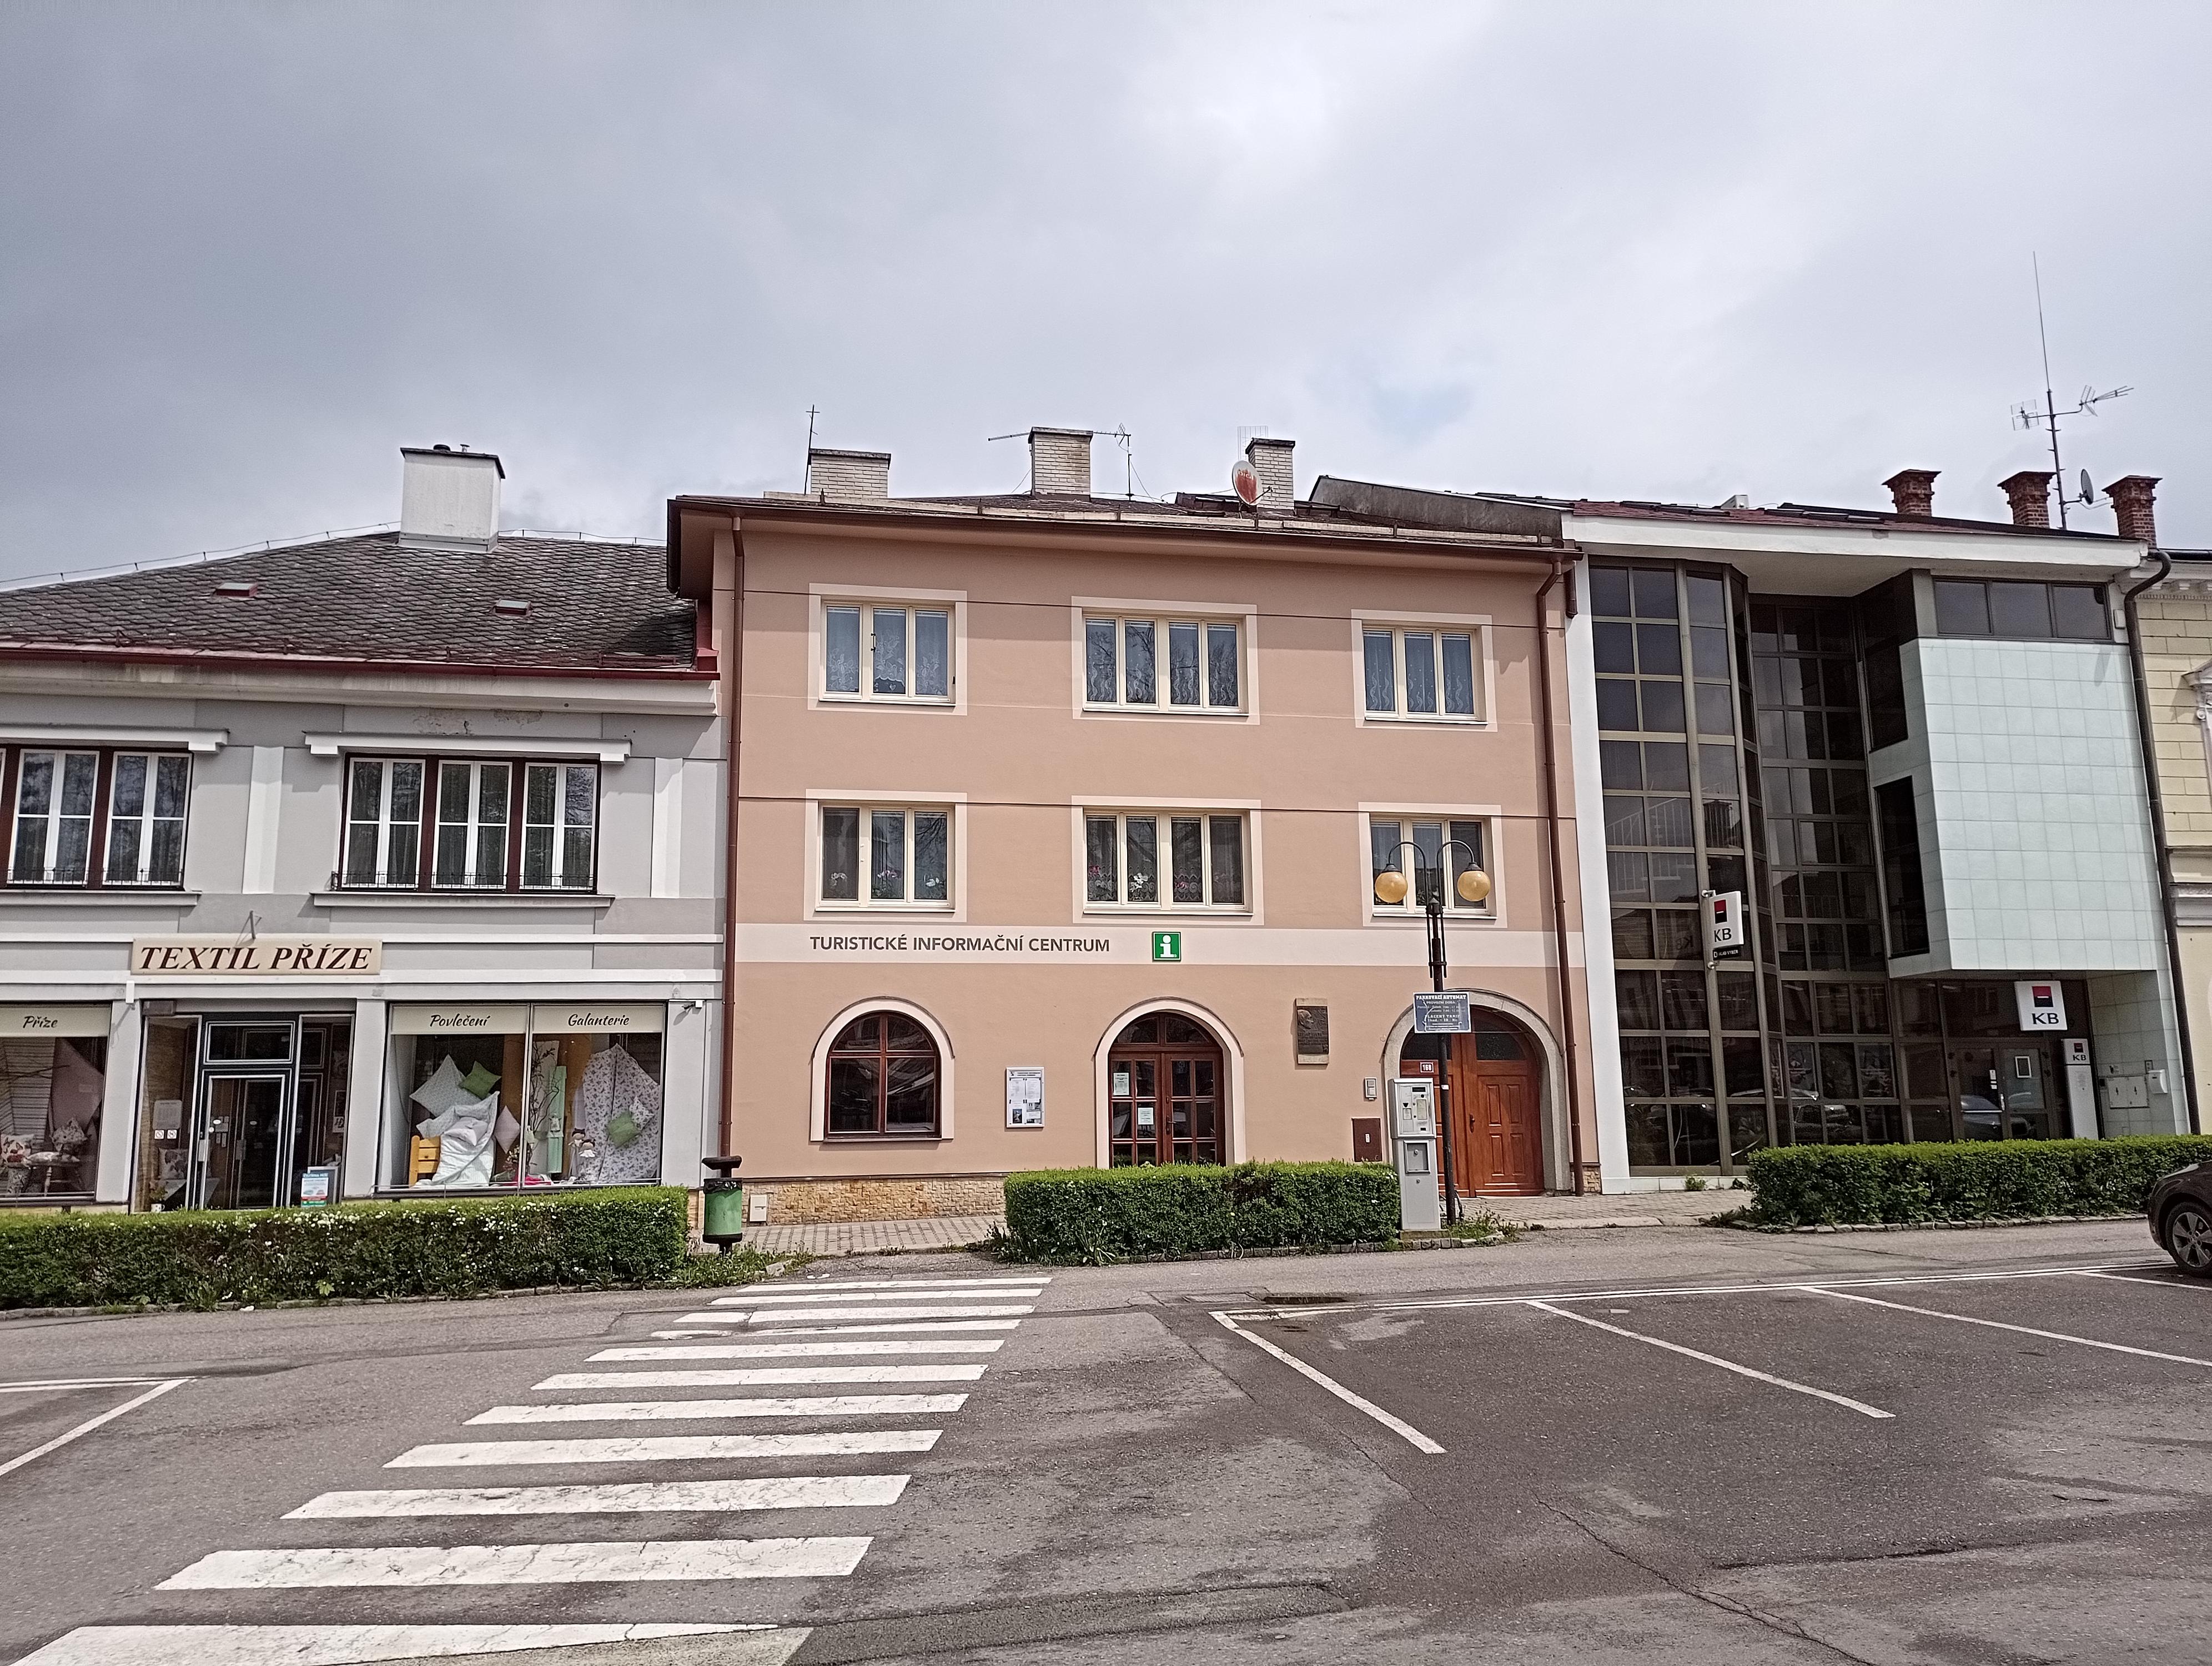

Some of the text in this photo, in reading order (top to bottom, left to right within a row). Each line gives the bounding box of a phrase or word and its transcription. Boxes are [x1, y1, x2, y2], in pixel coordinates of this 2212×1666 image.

[1713, 928, 1732, 942] KB
[810, 934, 1109, 952] TURISTICKÉ INFORMAČNÍ CENTRUM
[141, 944, 373, 970] TEXTIL PŘÍZE
[23, 1016, 58, 1028] Příze
[430, 1013, 491, 1027] Povlečení
[568, 1012, 630, 1026] Galanterie
[2032, 1013, 2059, 1025] KB
